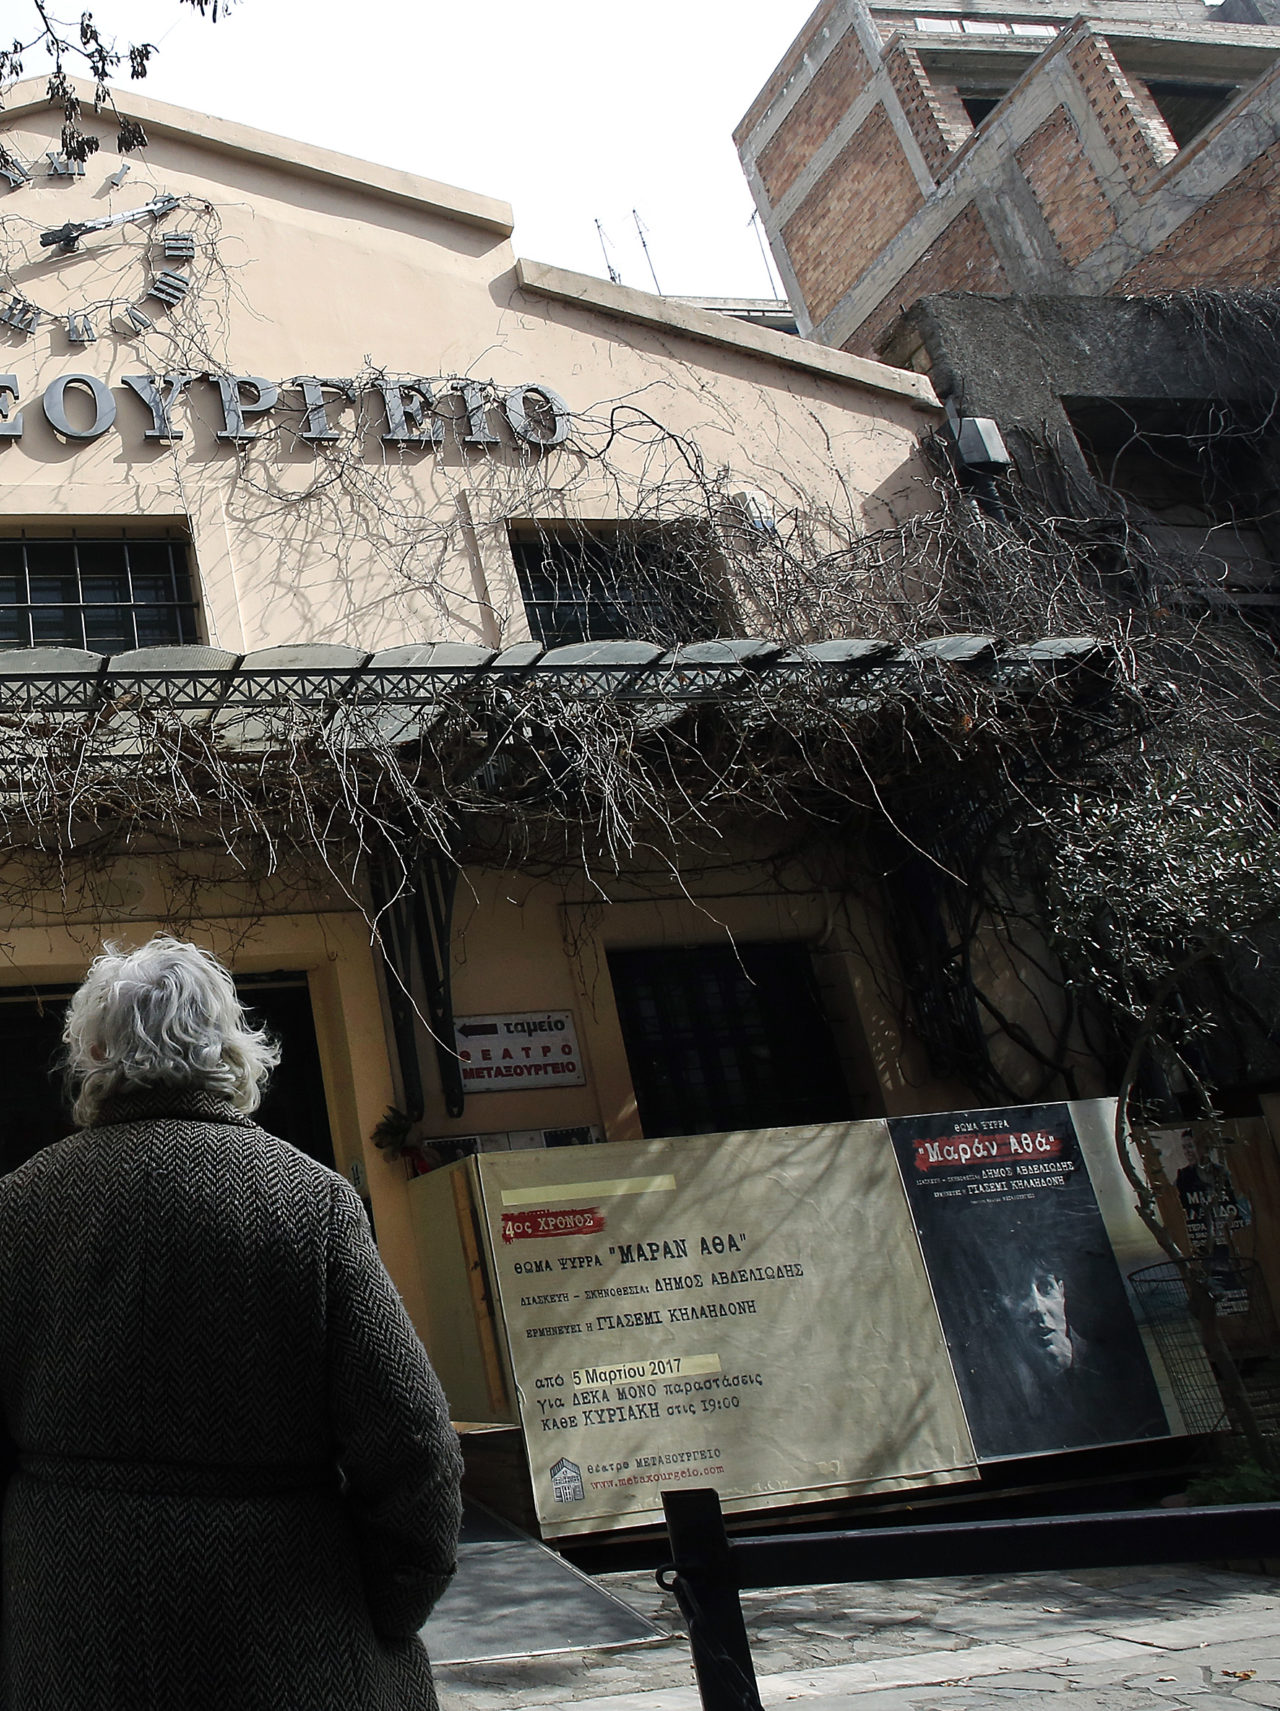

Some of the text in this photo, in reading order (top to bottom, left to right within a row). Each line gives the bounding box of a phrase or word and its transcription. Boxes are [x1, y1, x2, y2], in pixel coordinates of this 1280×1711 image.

[503, 1014, 566, 1038] ταμείο
[459, 1043, 573, 1062] ΘΕΑΤΡΟ
[462, 1061, 577, 1081] ΜΕΤΑΞΟΥΡΓΕΙΟ
[954, 1122, 979, 1133] ΘΩΜΑ
[981, 1167, 1013, 1180] ΔΗΜΟΣ
[1016, 1161, 1075, 1177] ΑΒΔΕΛΙΩΔΗΣ
[966, 1181, 1008, 1195] ΓΙΑΣΕΜΙ
[537, 1213, 595, 1232] ΧΡΟΝΟΣ
[513, 1232, 748, 1275] ΘΩΜΑ ΨΥΡΡΑ "ΜΑΡΑΝ ΑΘΑ"
[519, 1292, 570, 1307] ΔΙΑΣΚΕΥΗ
[584, 1285, 651, 1301] ΣΚΗΝΟΘΕΣΙΑ:
[654, 1274, 704, 1292] ΔΗΜΟΣ
[710, 1263, 805, 1286] ΑΒΔΕΛΙΩΔΗΣ
[525, 1299, 758, 1339] ΕΡΜΗΝΕΥΕΙ Η ΓΙΑΣΕΜΙ ΚΗΛΑΗΔΟΝΗ
[535, 1358, 682, 1389] από 5 Μαρτίου 2017
[536, 1372, 764, 1415] για ΔΕΚΑ ΜΟΝΟ παραστάσεις
[540, 1395, 741, 1432] ΚΑΘΕ ΚΥΡΙΑΚΗ στις 19:00
[589, 1464, 725, 1491] www.metaxourgeio.com
